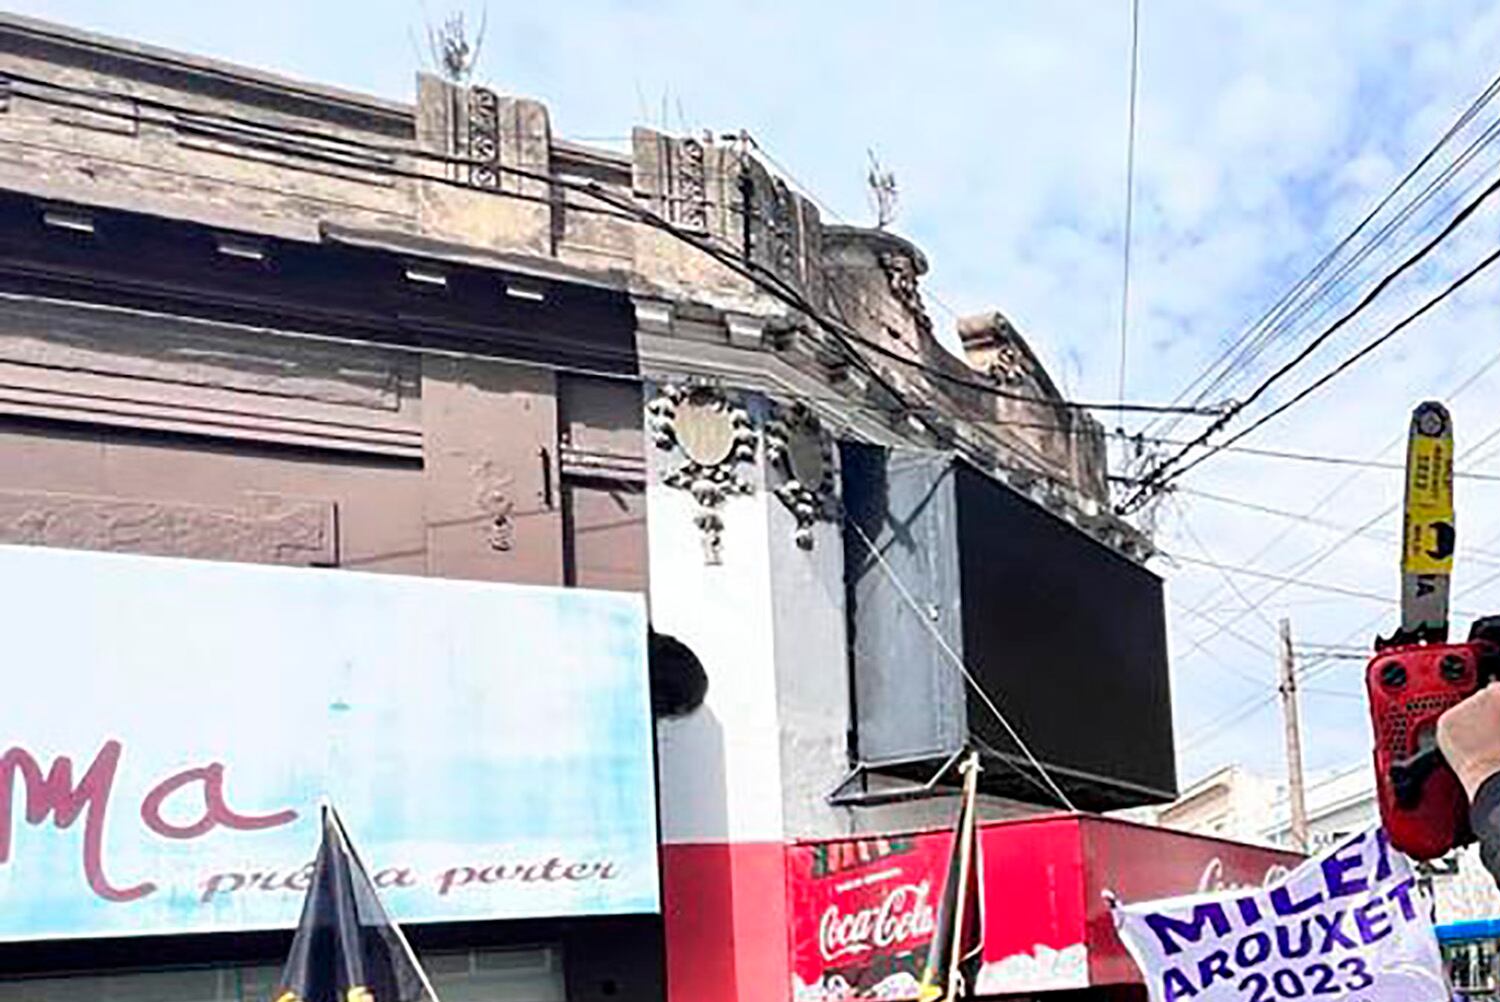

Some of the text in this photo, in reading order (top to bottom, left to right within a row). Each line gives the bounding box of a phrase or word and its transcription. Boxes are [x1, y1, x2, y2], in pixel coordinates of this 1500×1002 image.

[374, 866, 416, 888] a
[438, 856, 618, 896] porter
[1145, 826, 1393, 956] MILEI
[820, 879, 934, 961] Coca-Cola
